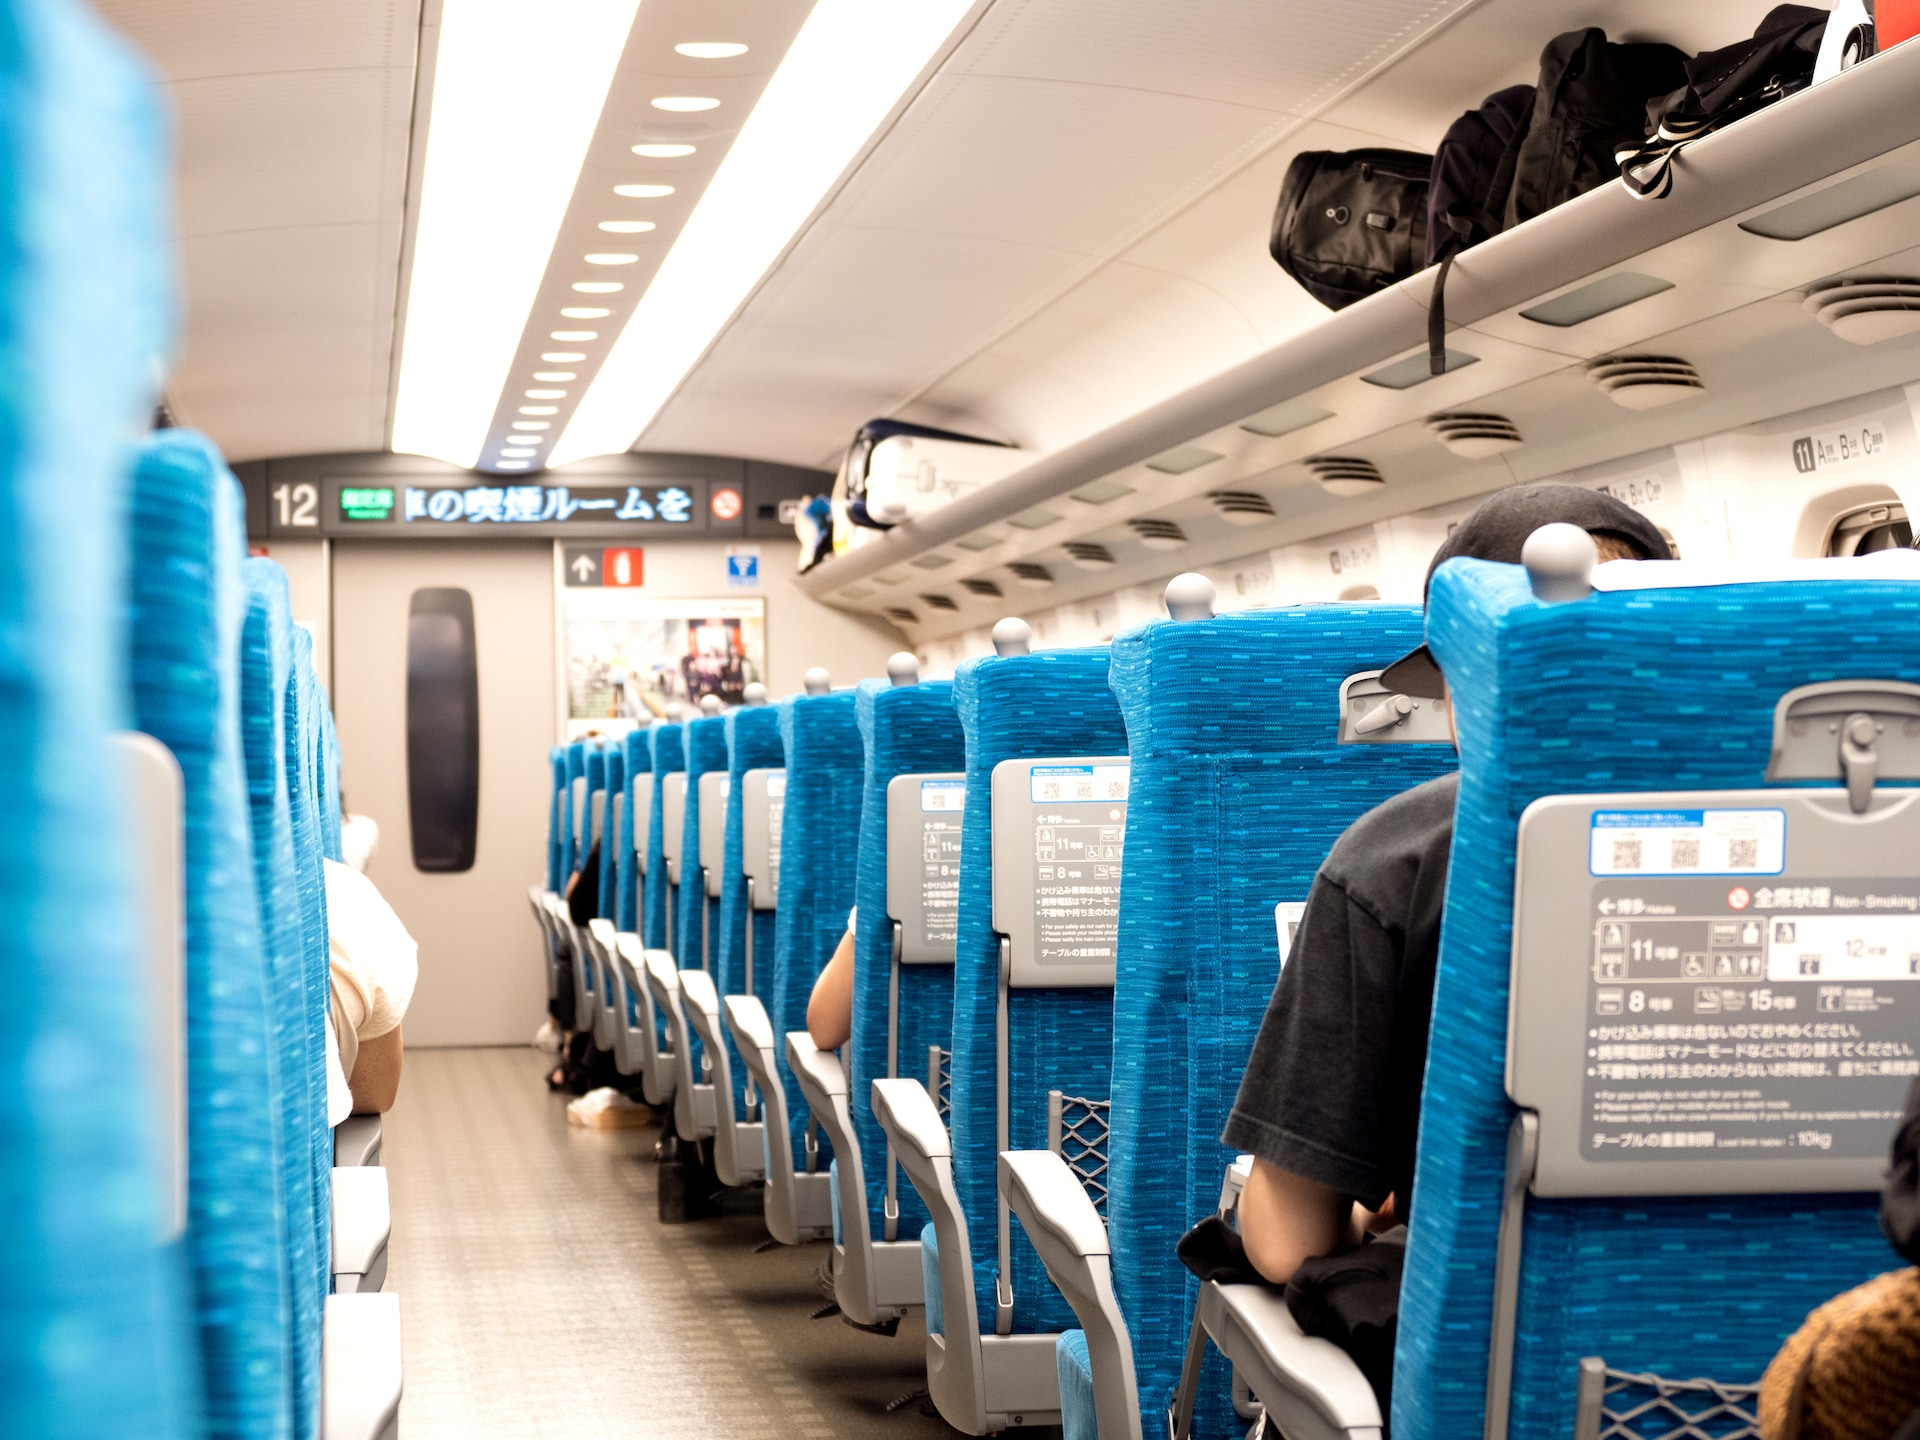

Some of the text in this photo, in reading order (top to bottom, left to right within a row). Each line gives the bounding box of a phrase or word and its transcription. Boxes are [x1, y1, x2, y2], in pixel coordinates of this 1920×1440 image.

[1796, 441, 1812, 471] 11
[1817, 439, 1828, 465] A
[1839, 433, 1850, 460] B
[1862, 428, 1872, 455] C
[273, 483, 319, 526] 12
[1753, 886, 1832, 909] 全席禁煙
[1591, 1131, 1716, 1149] テーブルの重量制限
